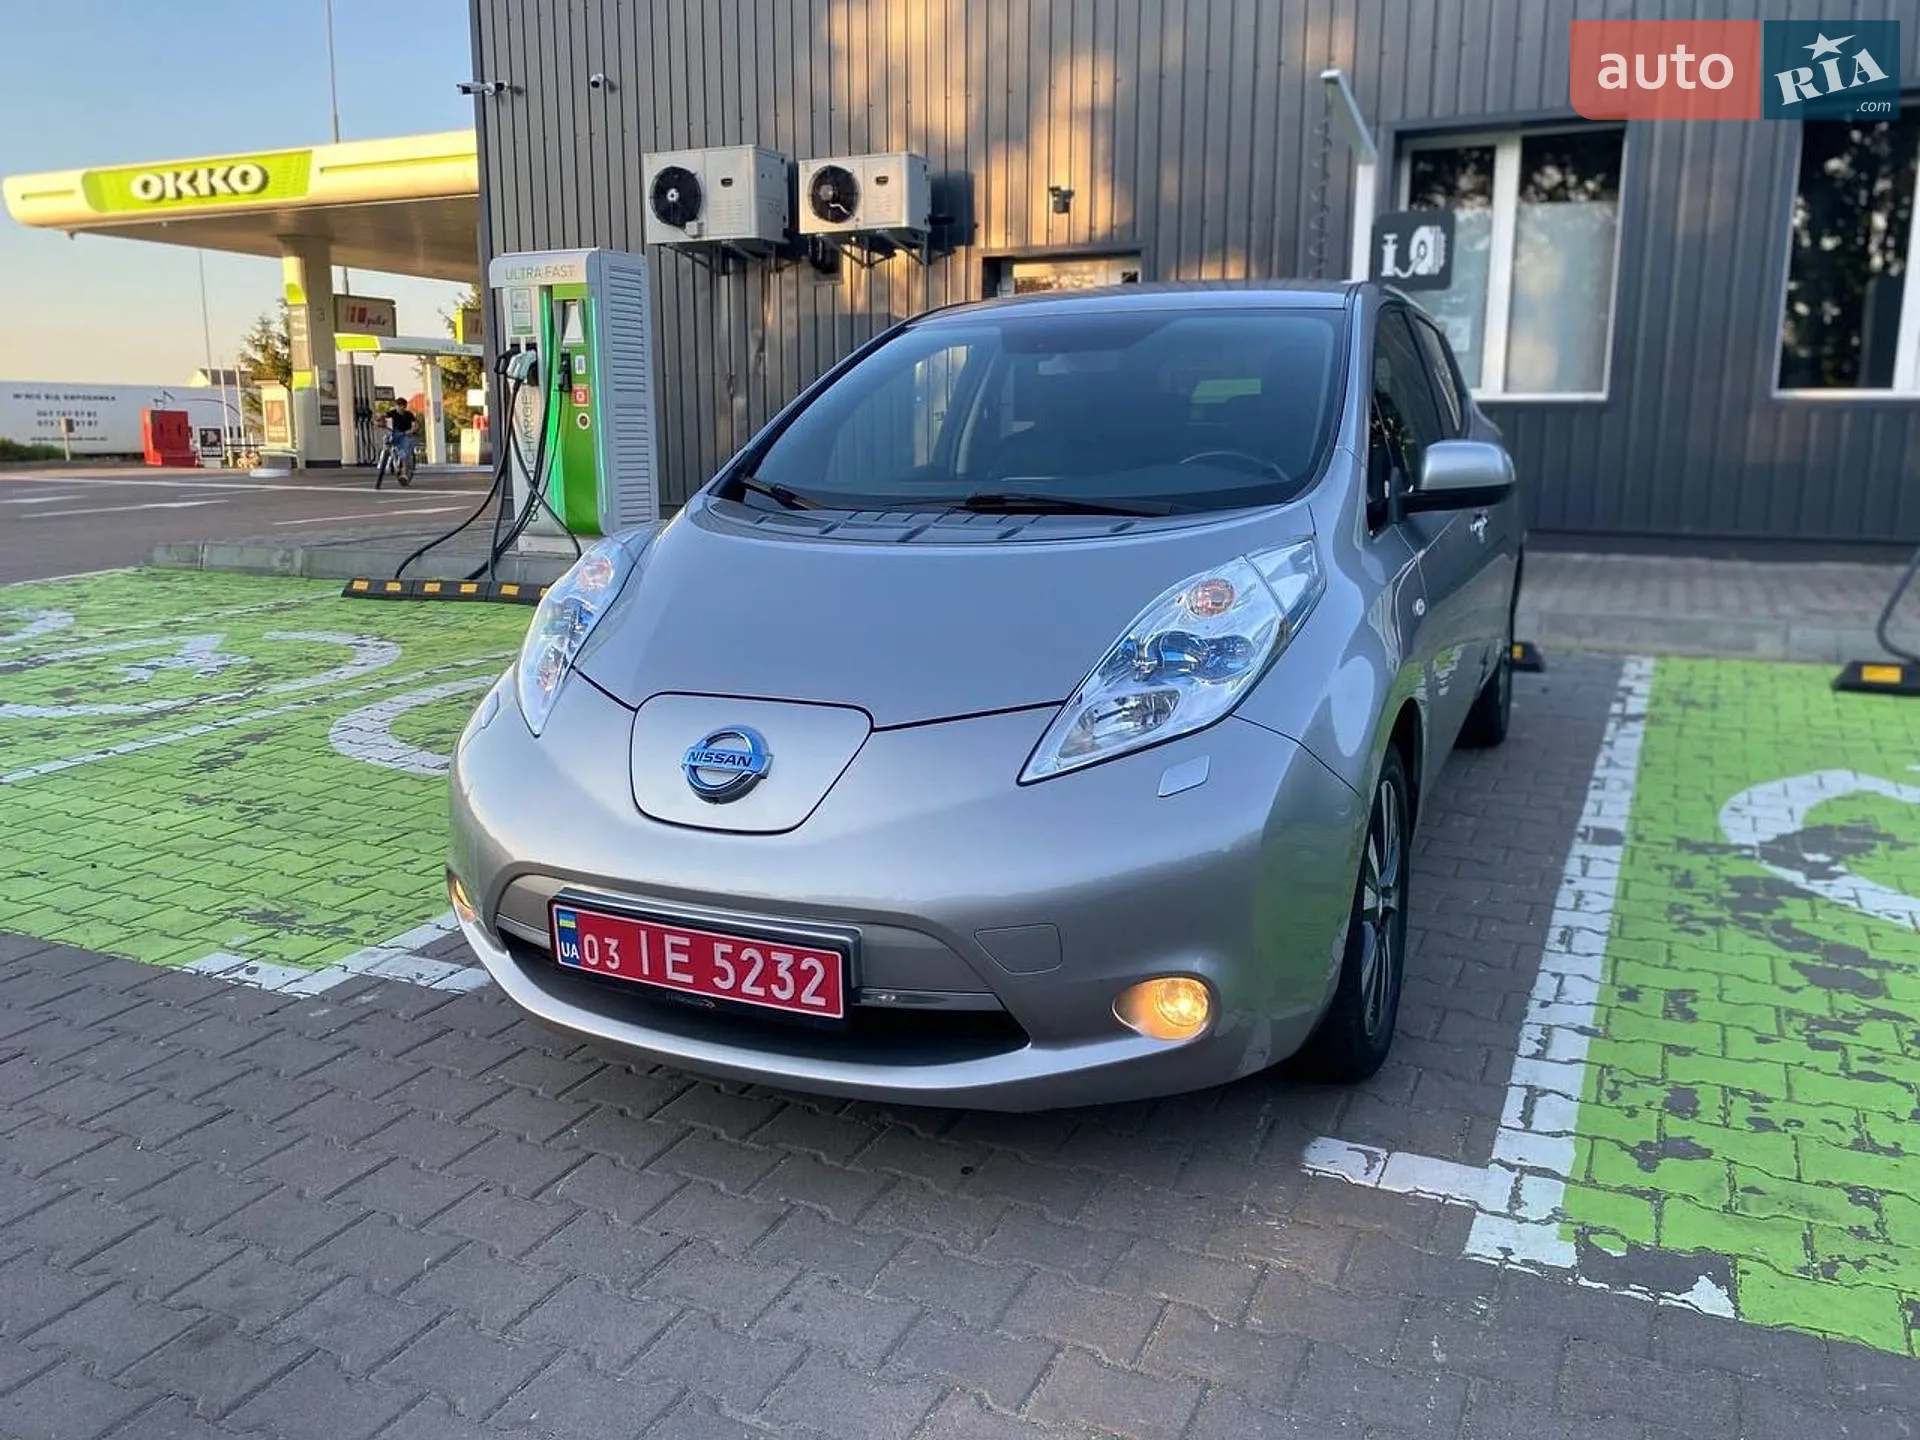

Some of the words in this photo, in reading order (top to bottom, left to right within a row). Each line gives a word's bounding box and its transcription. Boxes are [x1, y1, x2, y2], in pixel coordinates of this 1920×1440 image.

[130, 163, 267, 203] OKKO
[687, 751, 753, 768] NISSAN
[561, 942, 580, 960] UA
[583, 934, 621, 970] 03
[640, 929, 694, 984] IE
[712, 942, 827, 1007] 5232
